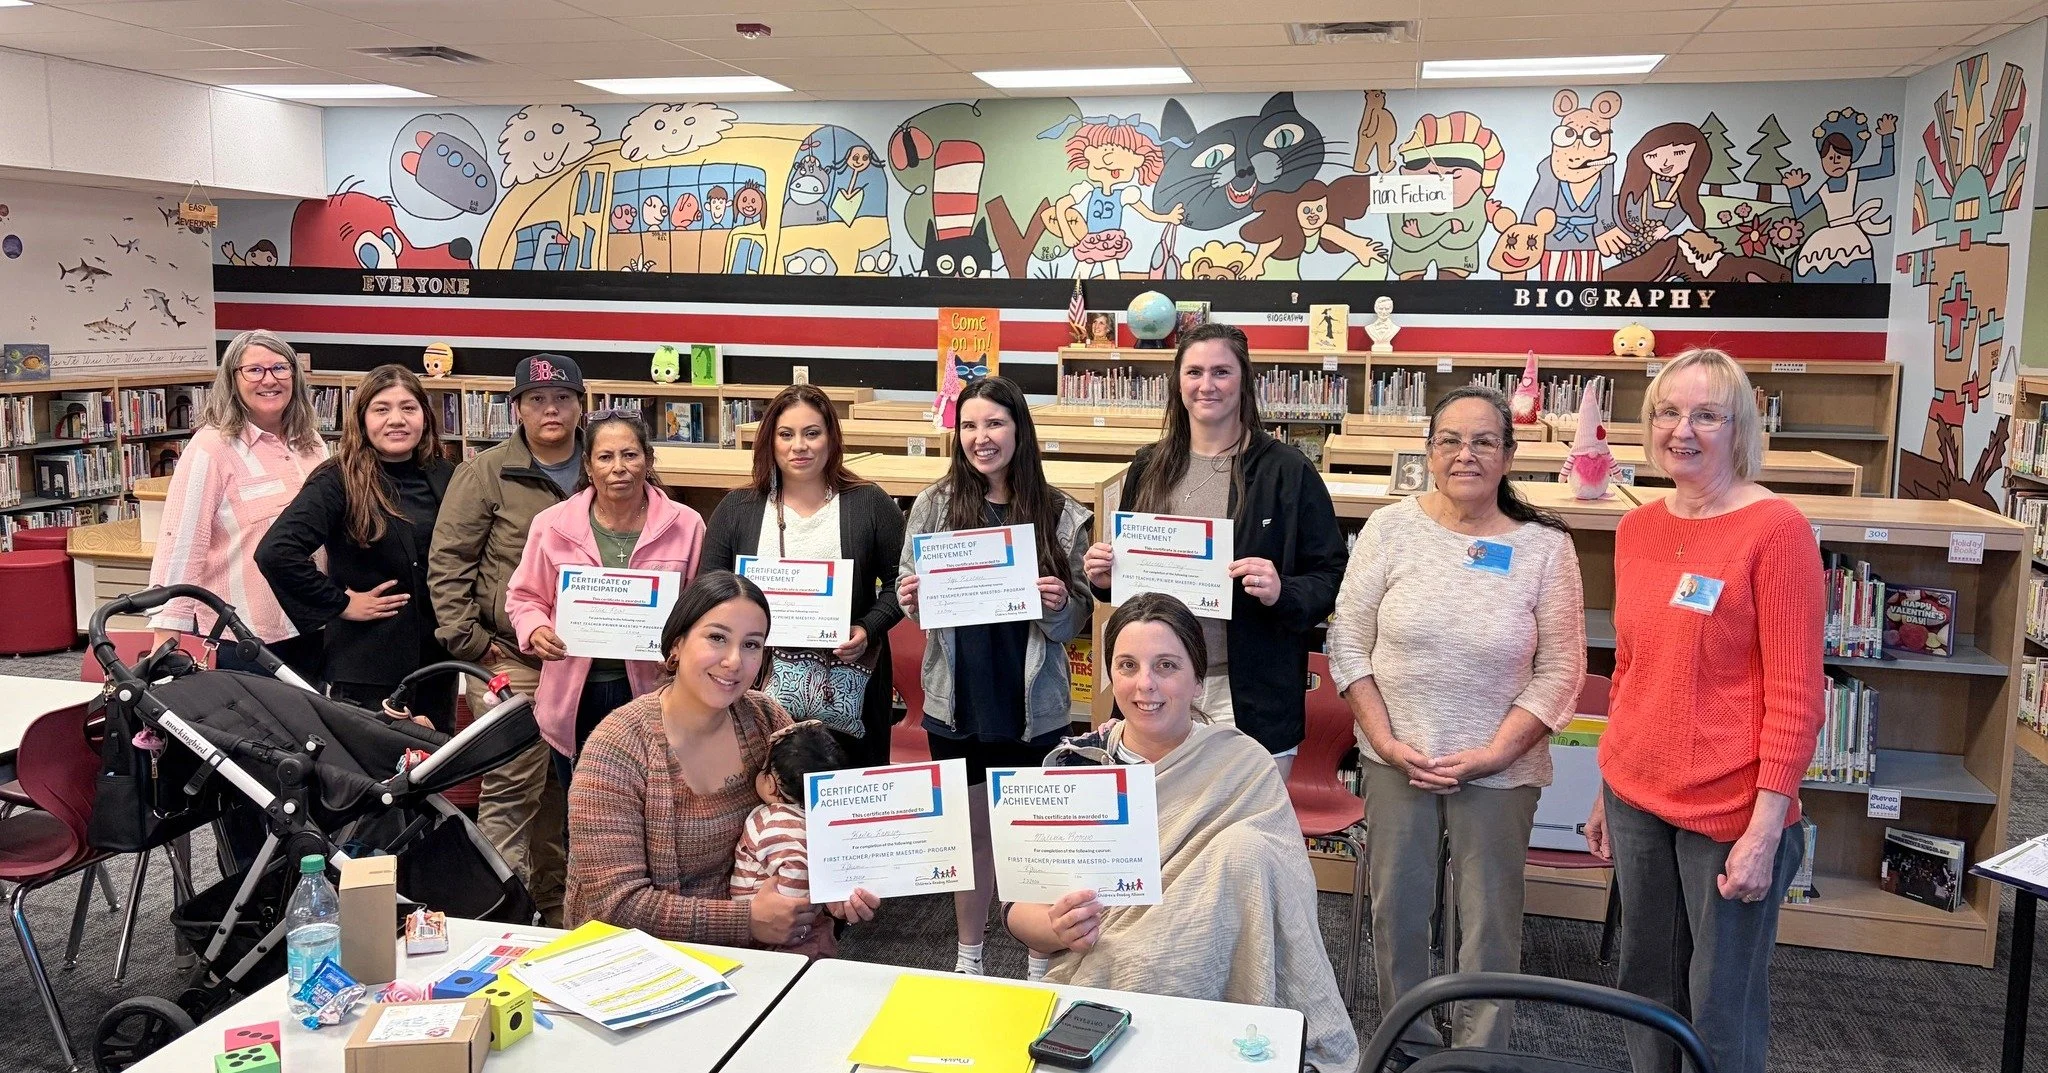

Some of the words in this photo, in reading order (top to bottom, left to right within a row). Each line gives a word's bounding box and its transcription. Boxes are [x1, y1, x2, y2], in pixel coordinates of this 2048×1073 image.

[1401, 184, 1446, 203] Fiction
[188, 203, 207, 212] EASY
[1093, 199, 1115, 219] 23
[180, 218, 216, 229] EVERYONE
[362, 275, 470, 296] EVERYONE
[1514, 287, 1716, 309] BIOGRAPHY
[952, 313, 987, 331] Come
[1267, 313, 1304, 323] BIOGRAPHY
[952, 337, 967, 352] on
[974, 333, 992, 352] in!
[1123, 524, 1165, 533] CERTIFICATE
[1123, 533, 1171, 542] ACHIEVEMENT
[1869, 530, 1887, 538] 300
[922, 542, 966, 552] CERTIFICATE
[923, 550, 972, 560] ACHIEVEMENT
[747, 567, 789, 575] CERTIFICATE
[572, 577, 619, 585] CERTIFICATE
[571, 584, 628, 593] PARTICIPATION
[1904, 601, 1931, 610] HAPPY
[1890, 606, 1944, 620] VALENTINE'S
[1906, 617, 1926, 625] DAY!
[165, 720, 208, 754] mockingbird
[820, 784, 878, 796] CERTIFICATE
[883, 782, 894, 790] OF
[1003, 785, 1061, 794] CERTIFICATE
[1064, 785, 1076, 793] OF
[821, 794, 888, 807] ACHIEVEMENT
[1003, 797, 1069, 805] ACHIEVEMENT
[1871, 794, 1898, 803] Steven
[842, 852, 894, 861] TEACHER/PRIMER
